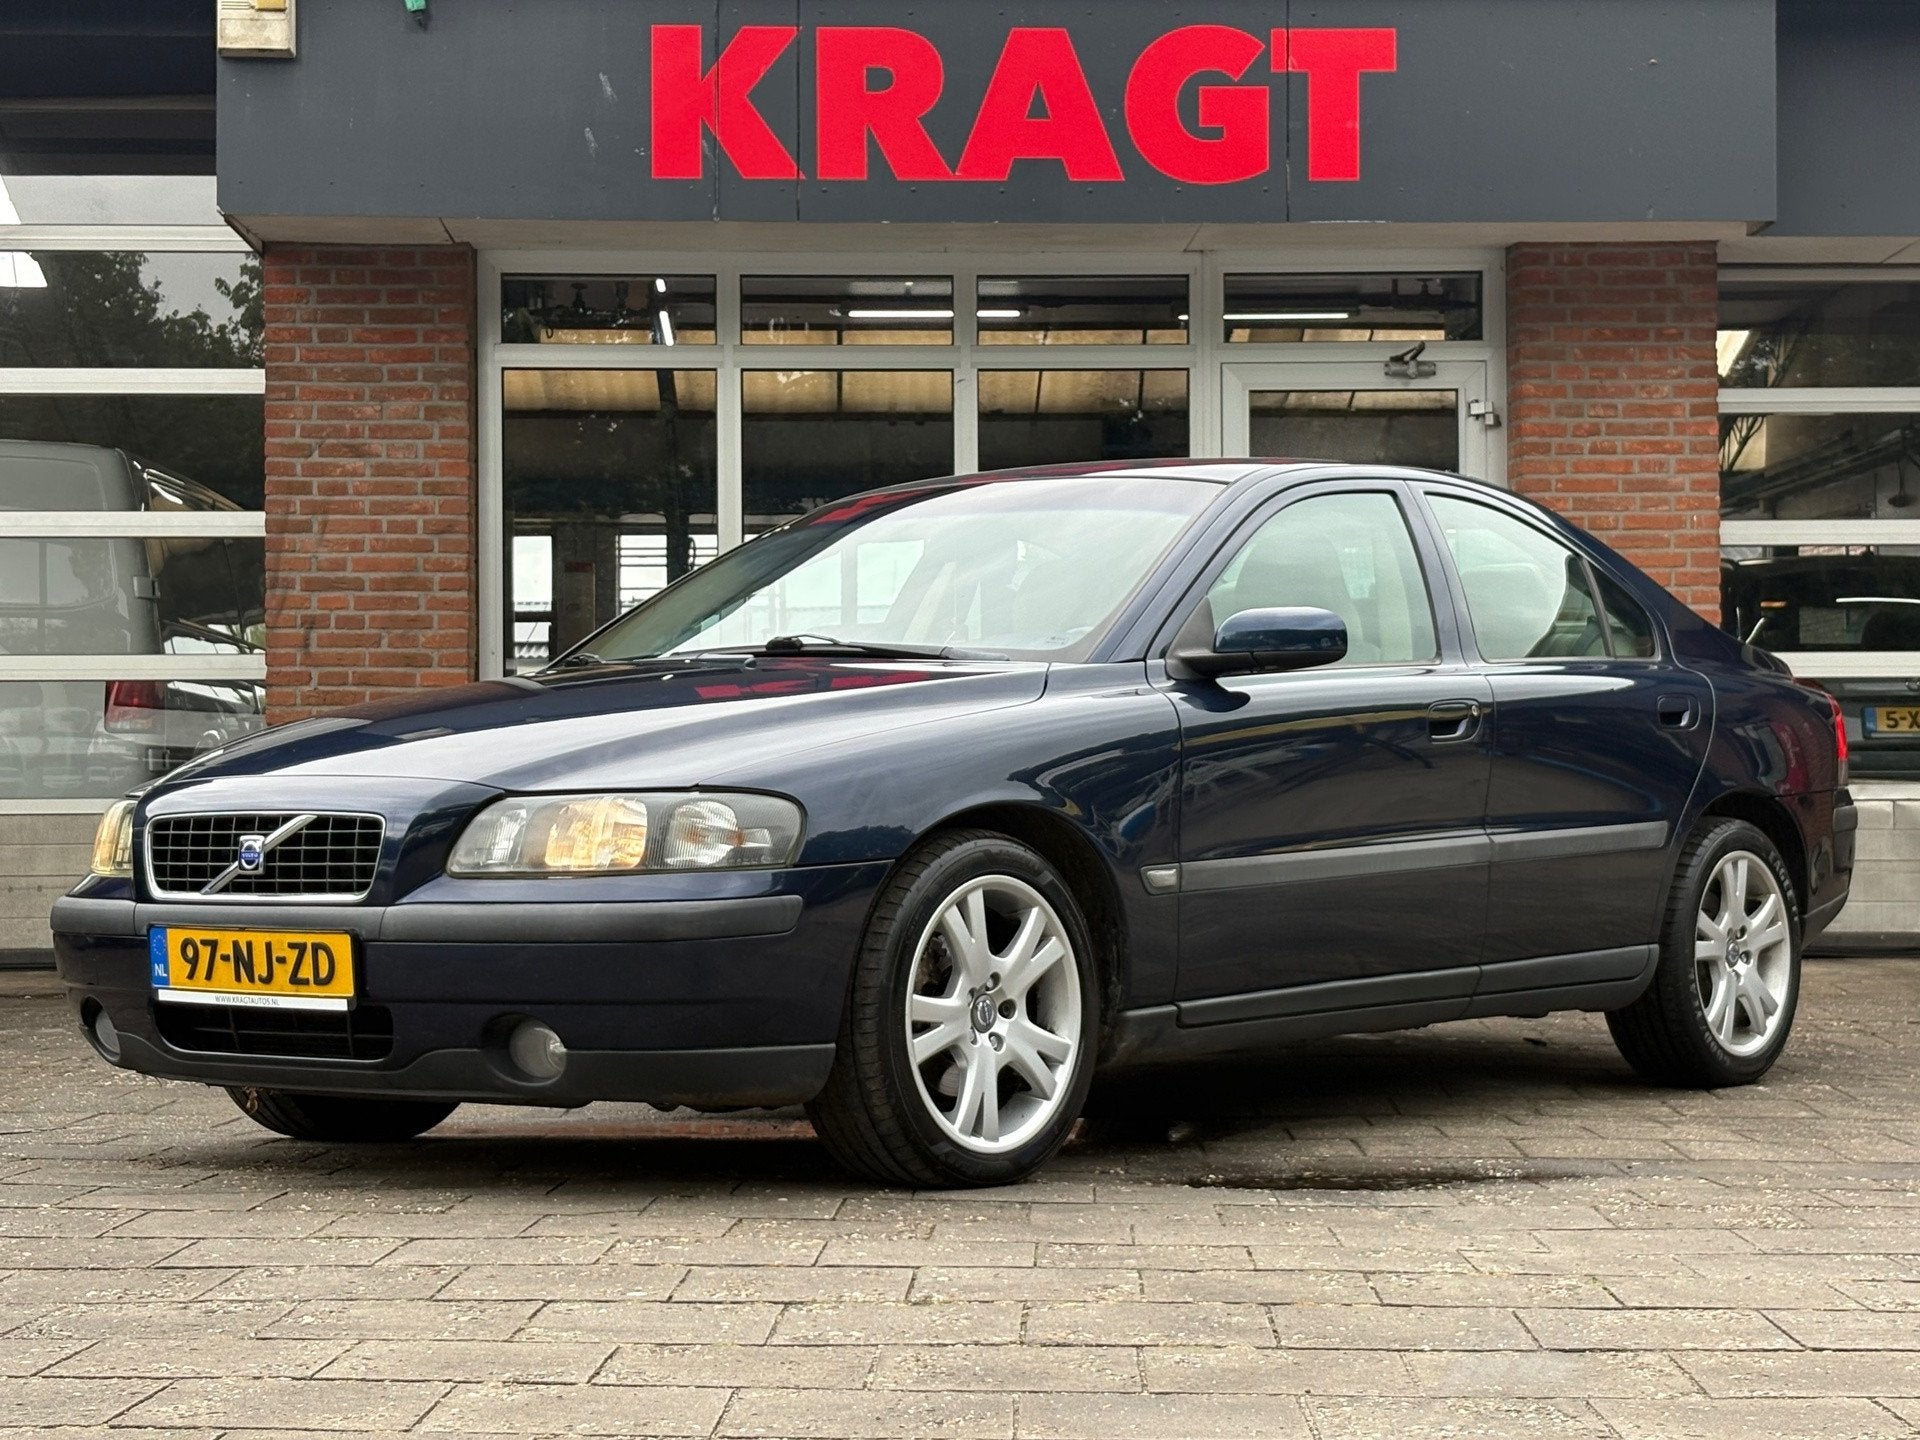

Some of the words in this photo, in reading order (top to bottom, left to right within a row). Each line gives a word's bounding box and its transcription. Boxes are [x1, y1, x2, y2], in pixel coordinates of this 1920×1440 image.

[650, 25, 1398, 184] KRAGT
[154, 963, 168, 977] NL
[180, 937, 336, 986] 97-NJ-ZD
[214, 995, 280, 1006] WWW.KRAGTAUTOS.NL
